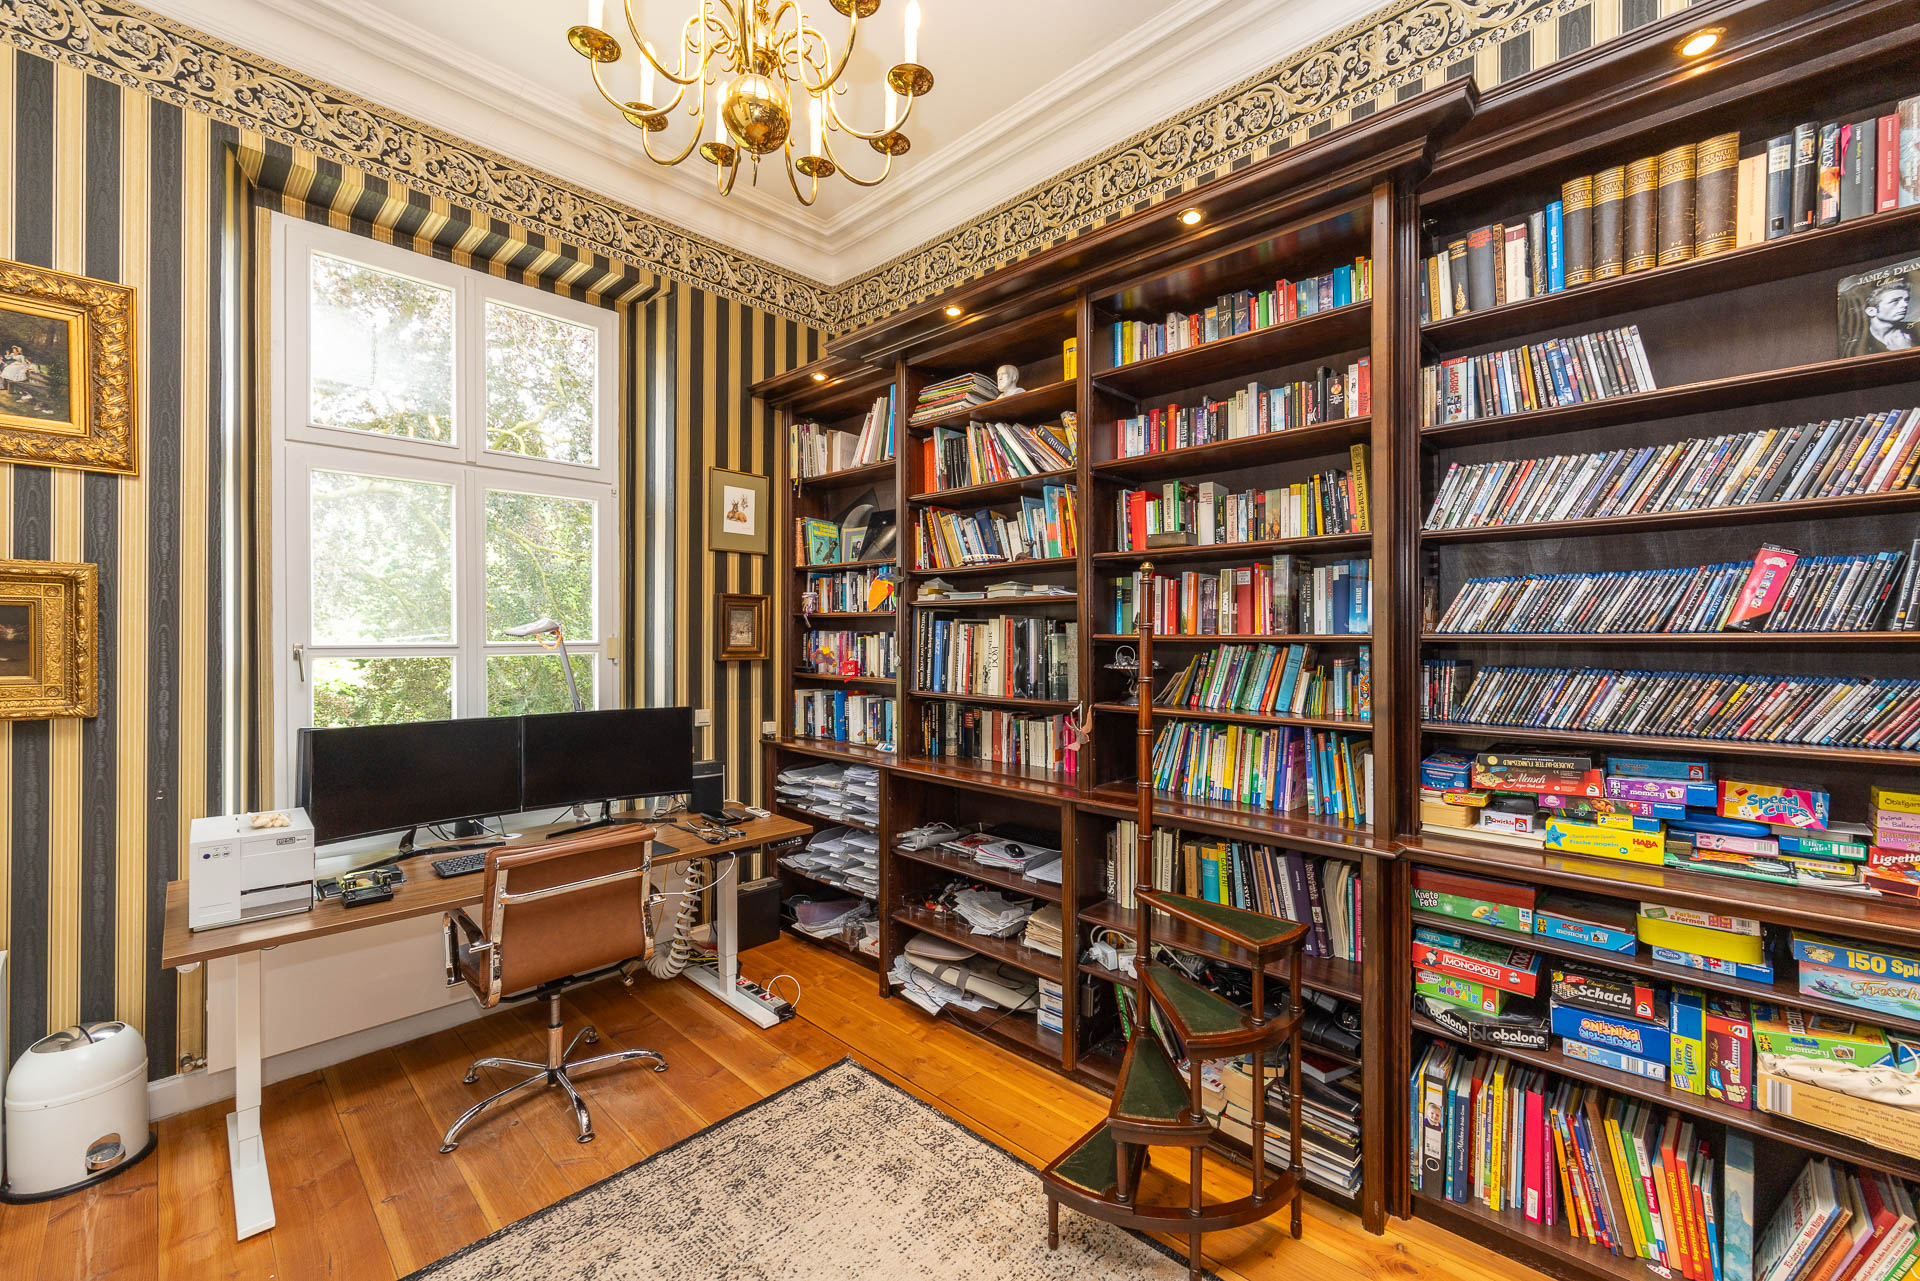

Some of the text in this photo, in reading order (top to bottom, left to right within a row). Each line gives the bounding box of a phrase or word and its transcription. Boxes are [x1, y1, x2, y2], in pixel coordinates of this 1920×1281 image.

[1703, 148, 1733, 161] DER NEUE
[1662, 159, 1690, 172] DER NEUE
[1706, 231, 1728, 239] ATLAS
[1857, 262, 1920, 285] JAMES DEAN
[1353, 461, 1364, 505] BUSCH-BUCH
[1515, 772, 1546, 785] Mensch
[1630, 790, 1665, 799] memory
[1746, 793, 1799, 808] Speed
[1763, 802, 1809, 818] Cups
[1600, 816, 1607, 824] 2
[1633, 838, 1658, 849] HABA
[1872, 853, 1920, 867] Ligretto
[1414, 889, 1439, 900] Knete
[1419, 898, 1438, 908] Fete
[1675, 911, 1701, 919] Farben
[1676, 916, 1706, 926] Formen
[1556, 928, 1590, 941] memory
[1444, 957, 1499, 978] MONOPOLY
[1846, 951, 1887, 974] 150
[1437, 984, 1479, 1005] MOSAIK
[1578, 985, 1632, 1005] Schach
[1851, 980, 1919, 1001] Frosch
[1430, 1008, 1468, 1035] abalone
[1493, 1029, 1545, 1045] abalone
[1581, 1018, 1640, 1041] PAINTING
[1580, 1028, 1642, 1052] PROJECTOR
[1673, 1047, 1682, 1066] Tiere
[1683, 1043, 1697, 1076] füttern
[1785, 1046, 1830, 1060] memory
[1677, 1230, 1689, 1255] Besuch
